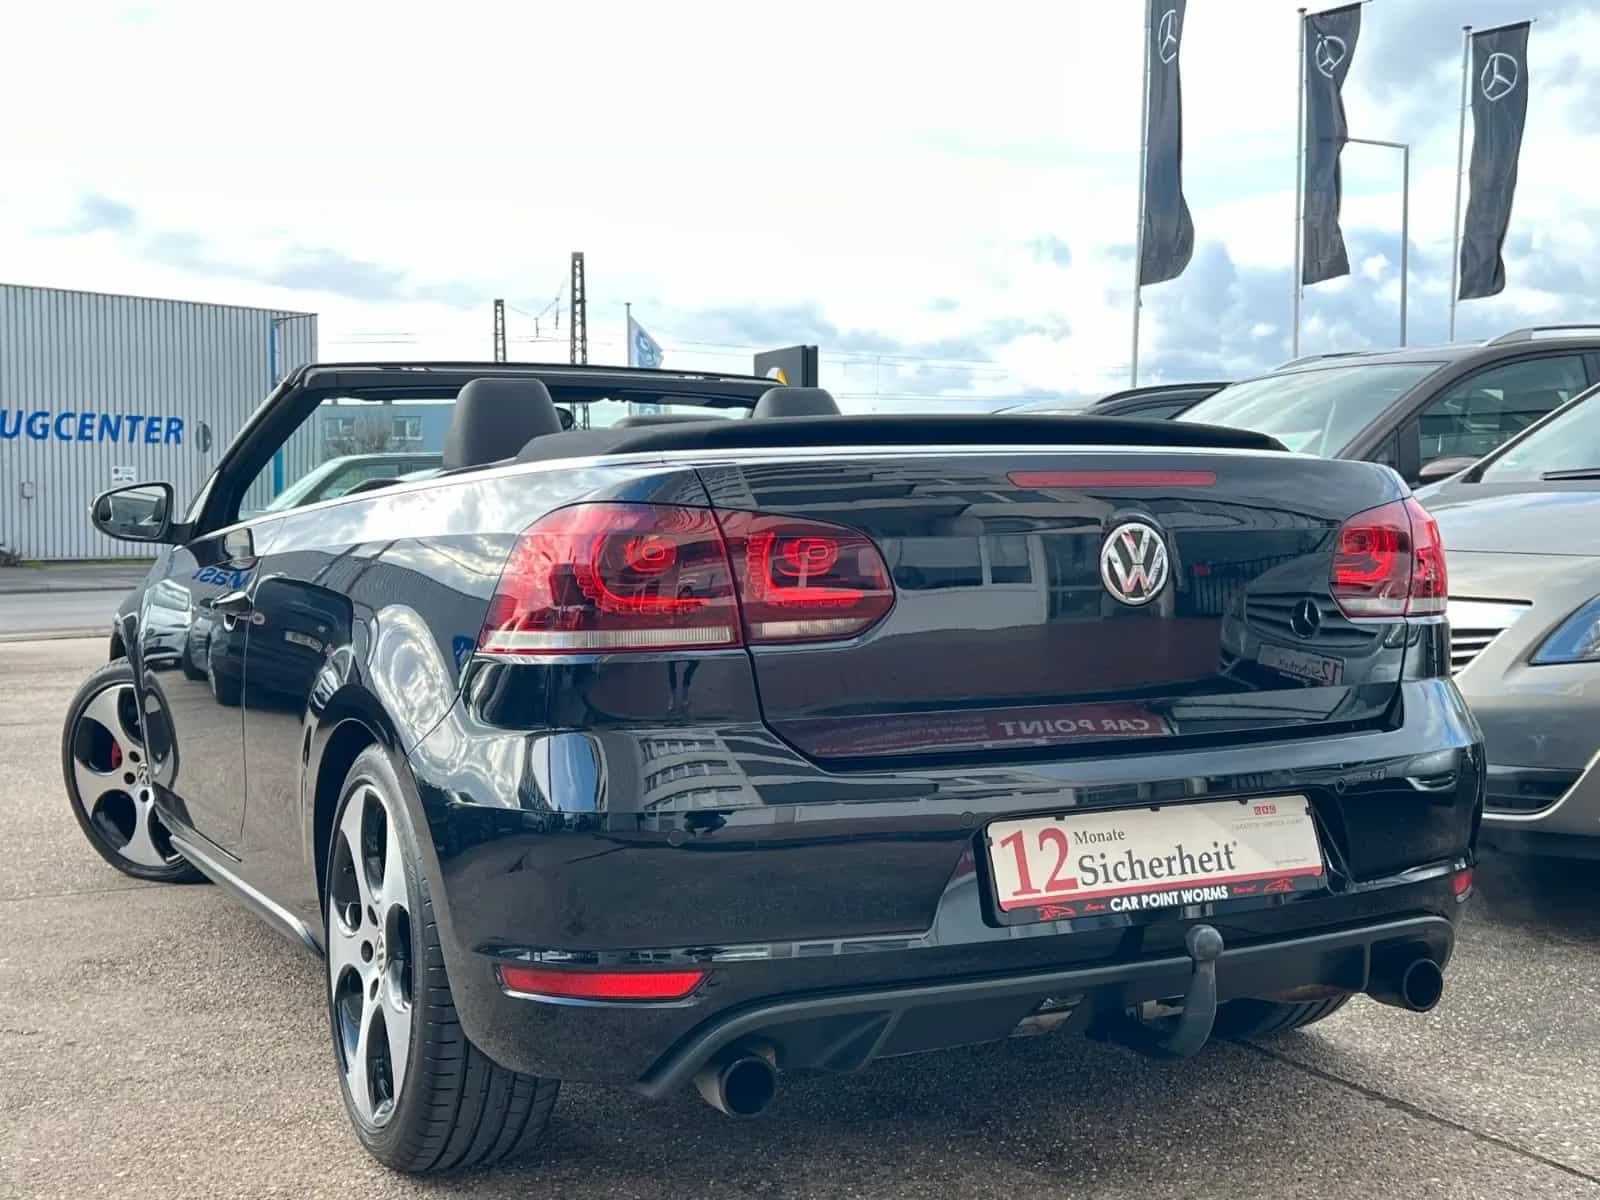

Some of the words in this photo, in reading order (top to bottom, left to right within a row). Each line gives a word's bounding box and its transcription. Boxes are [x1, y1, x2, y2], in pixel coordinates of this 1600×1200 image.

[0, 410, 184, 445] UGCENTER
[1000, 827, 1078, 897] 12
[1072, 829, 1126, 846] Monate
[1110, 896, 1139, 912] CAR
[1142, 890, 1179, 909] POINT
[1182, 886, 1229, 904] WORMS
